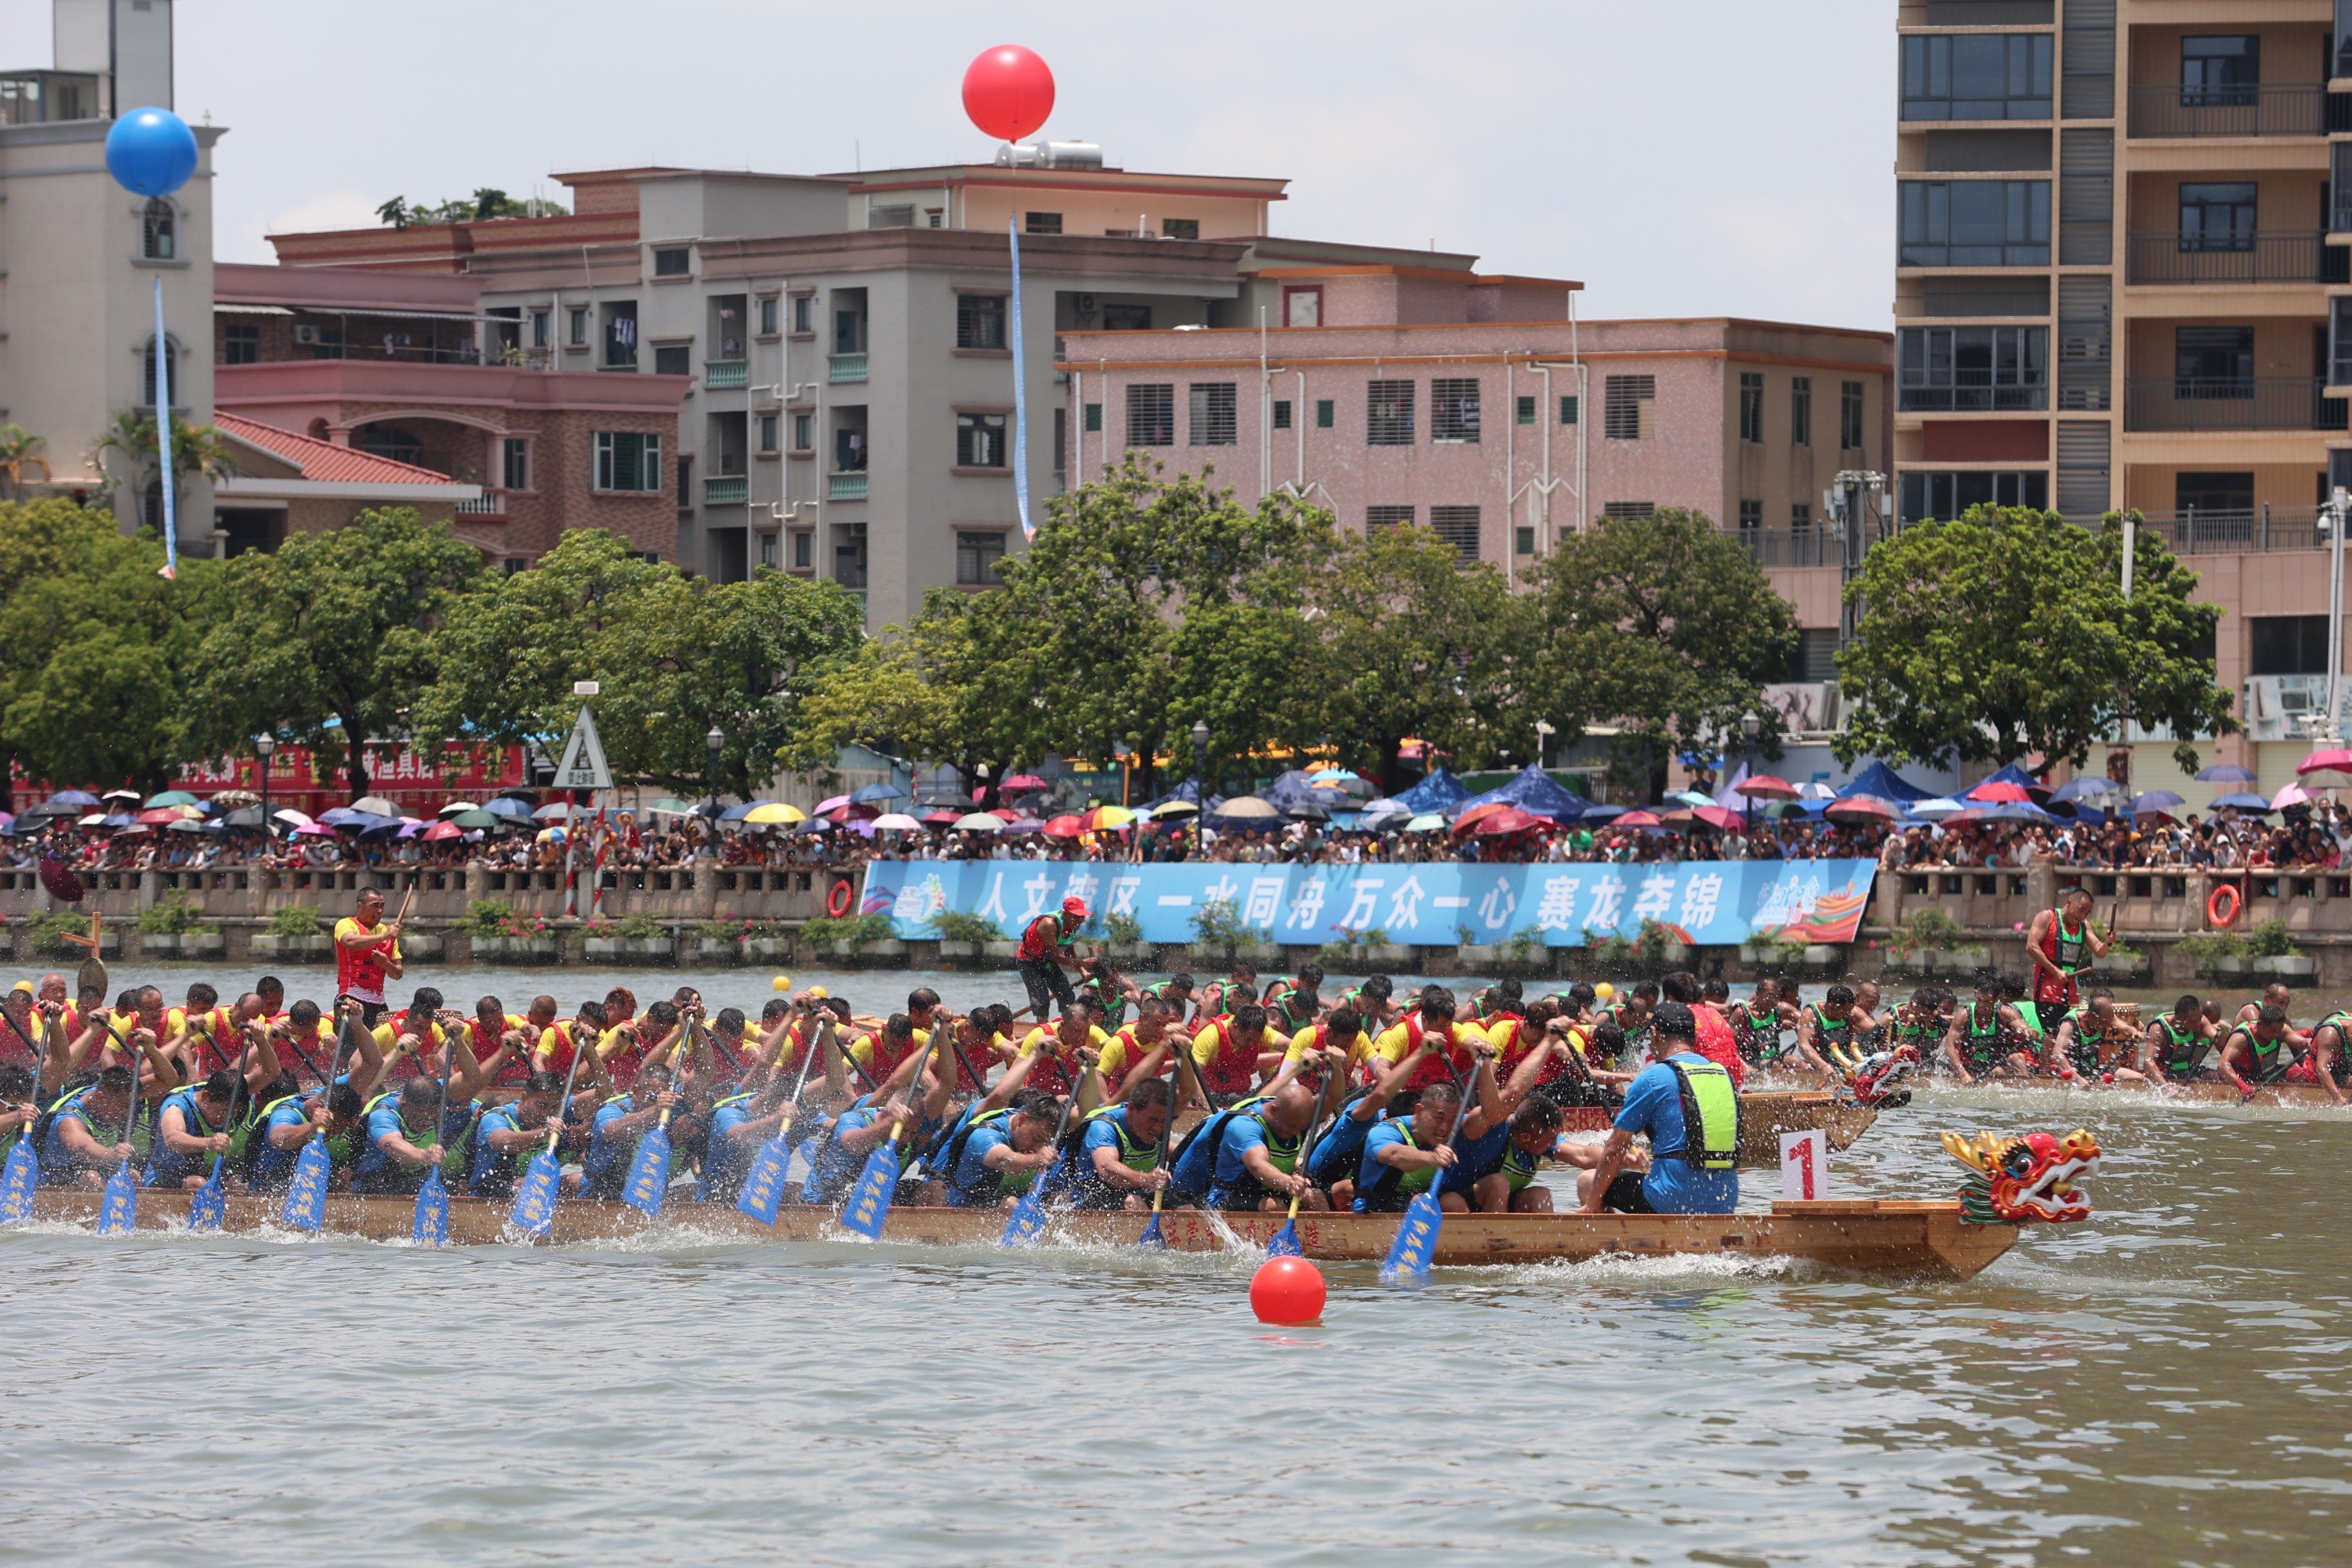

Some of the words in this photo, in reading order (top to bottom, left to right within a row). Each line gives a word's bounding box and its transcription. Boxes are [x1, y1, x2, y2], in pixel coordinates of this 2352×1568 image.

[1156, 874, 1326, 930] 一水同舟
[1340, 874, 1515, 930] 万众一心
[1537, 872, 1723, 931] 赛龙夺锦
[1788, 1137, 1814, 1200] 1
